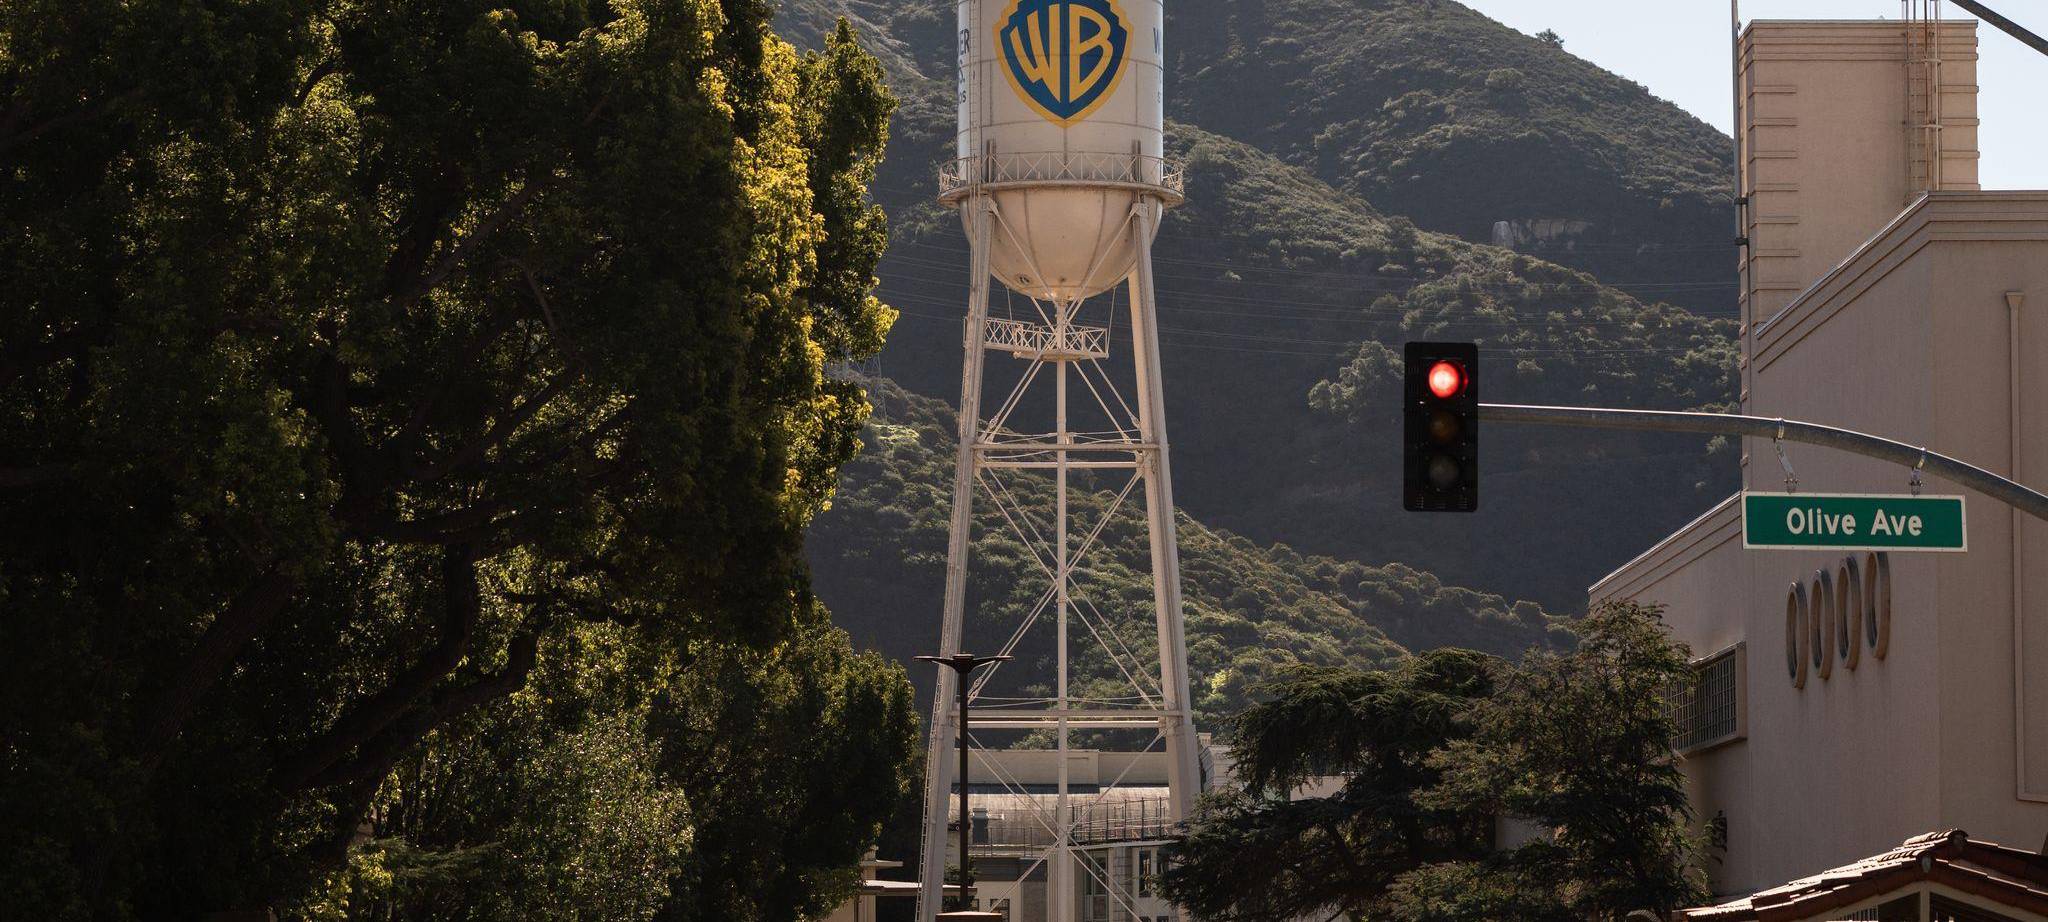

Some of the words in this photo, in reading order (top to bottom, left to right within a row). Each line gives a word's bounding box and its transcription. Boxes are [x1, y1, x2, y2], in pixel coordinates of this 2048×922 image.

[1009, 3, 1114, 104] WB
[1786, 507, 1856, 535] Olive
[1870, 508, 1923, 537] Ave
